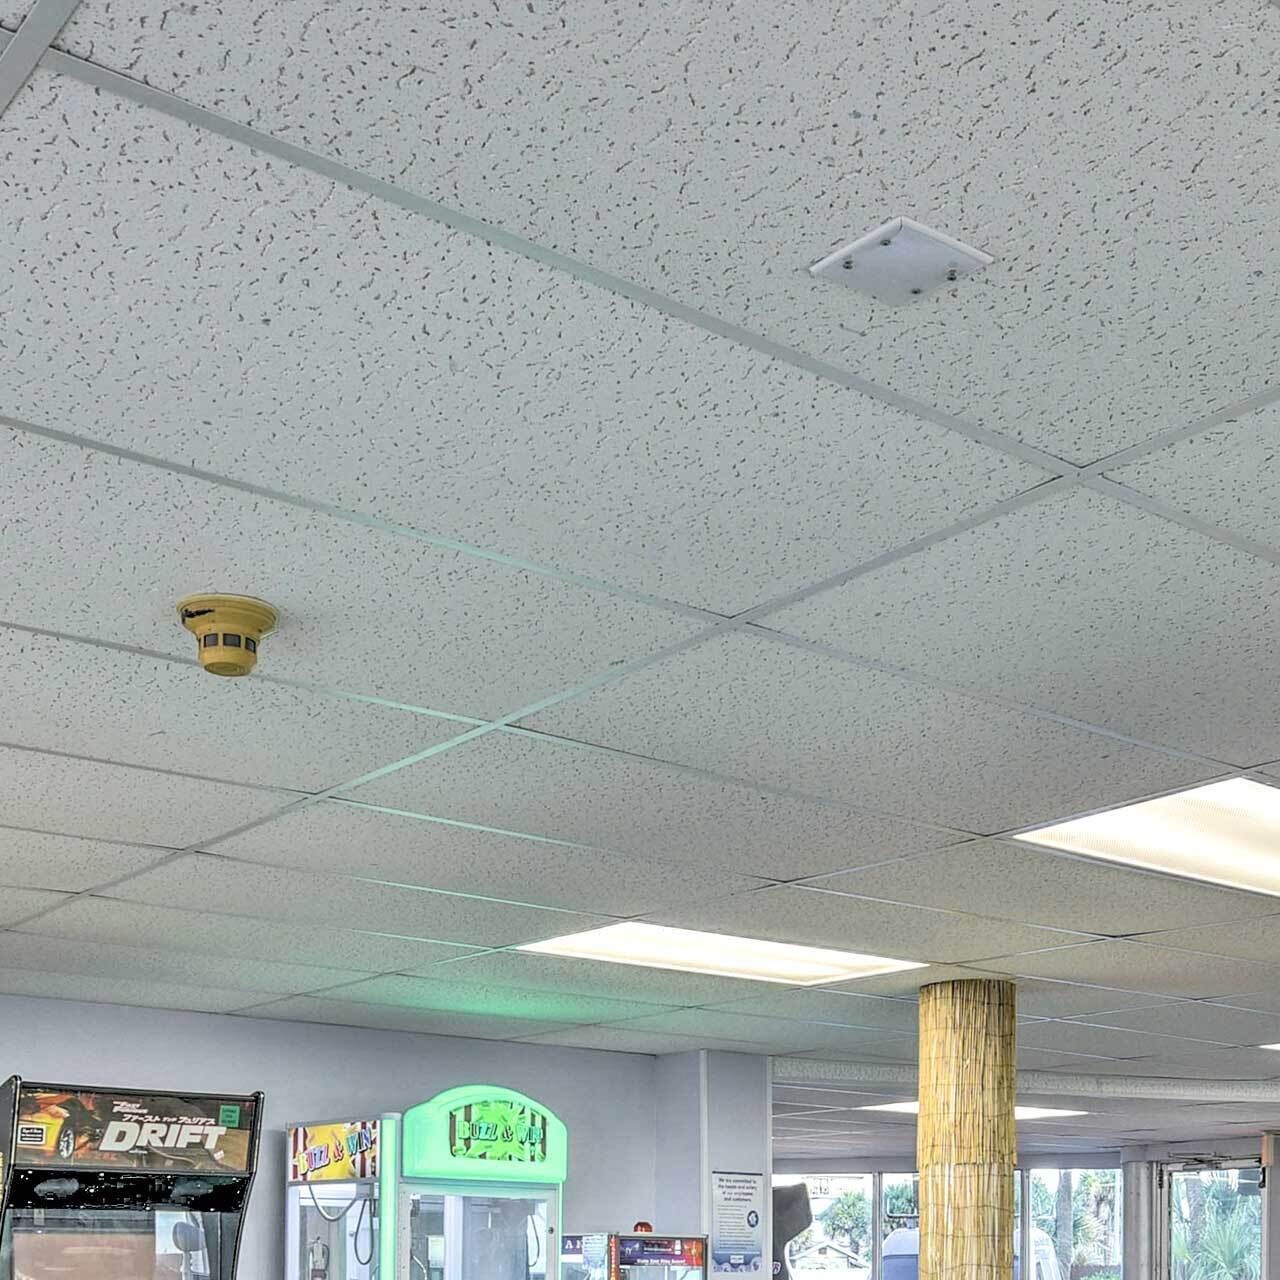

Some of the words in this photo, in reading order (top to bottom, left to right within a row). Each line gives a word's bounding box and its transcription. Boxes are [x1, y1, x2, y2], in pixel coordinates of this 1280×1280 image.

[98, 1120, 227, 1152] DRIFT
[457, 1120, 499, 1142] BUZZ
[517, 1123, 544, 1145] WIN
[297, 1143, 331, 1176] BUZZ
[346, 1127, 373, 1157] WIN
